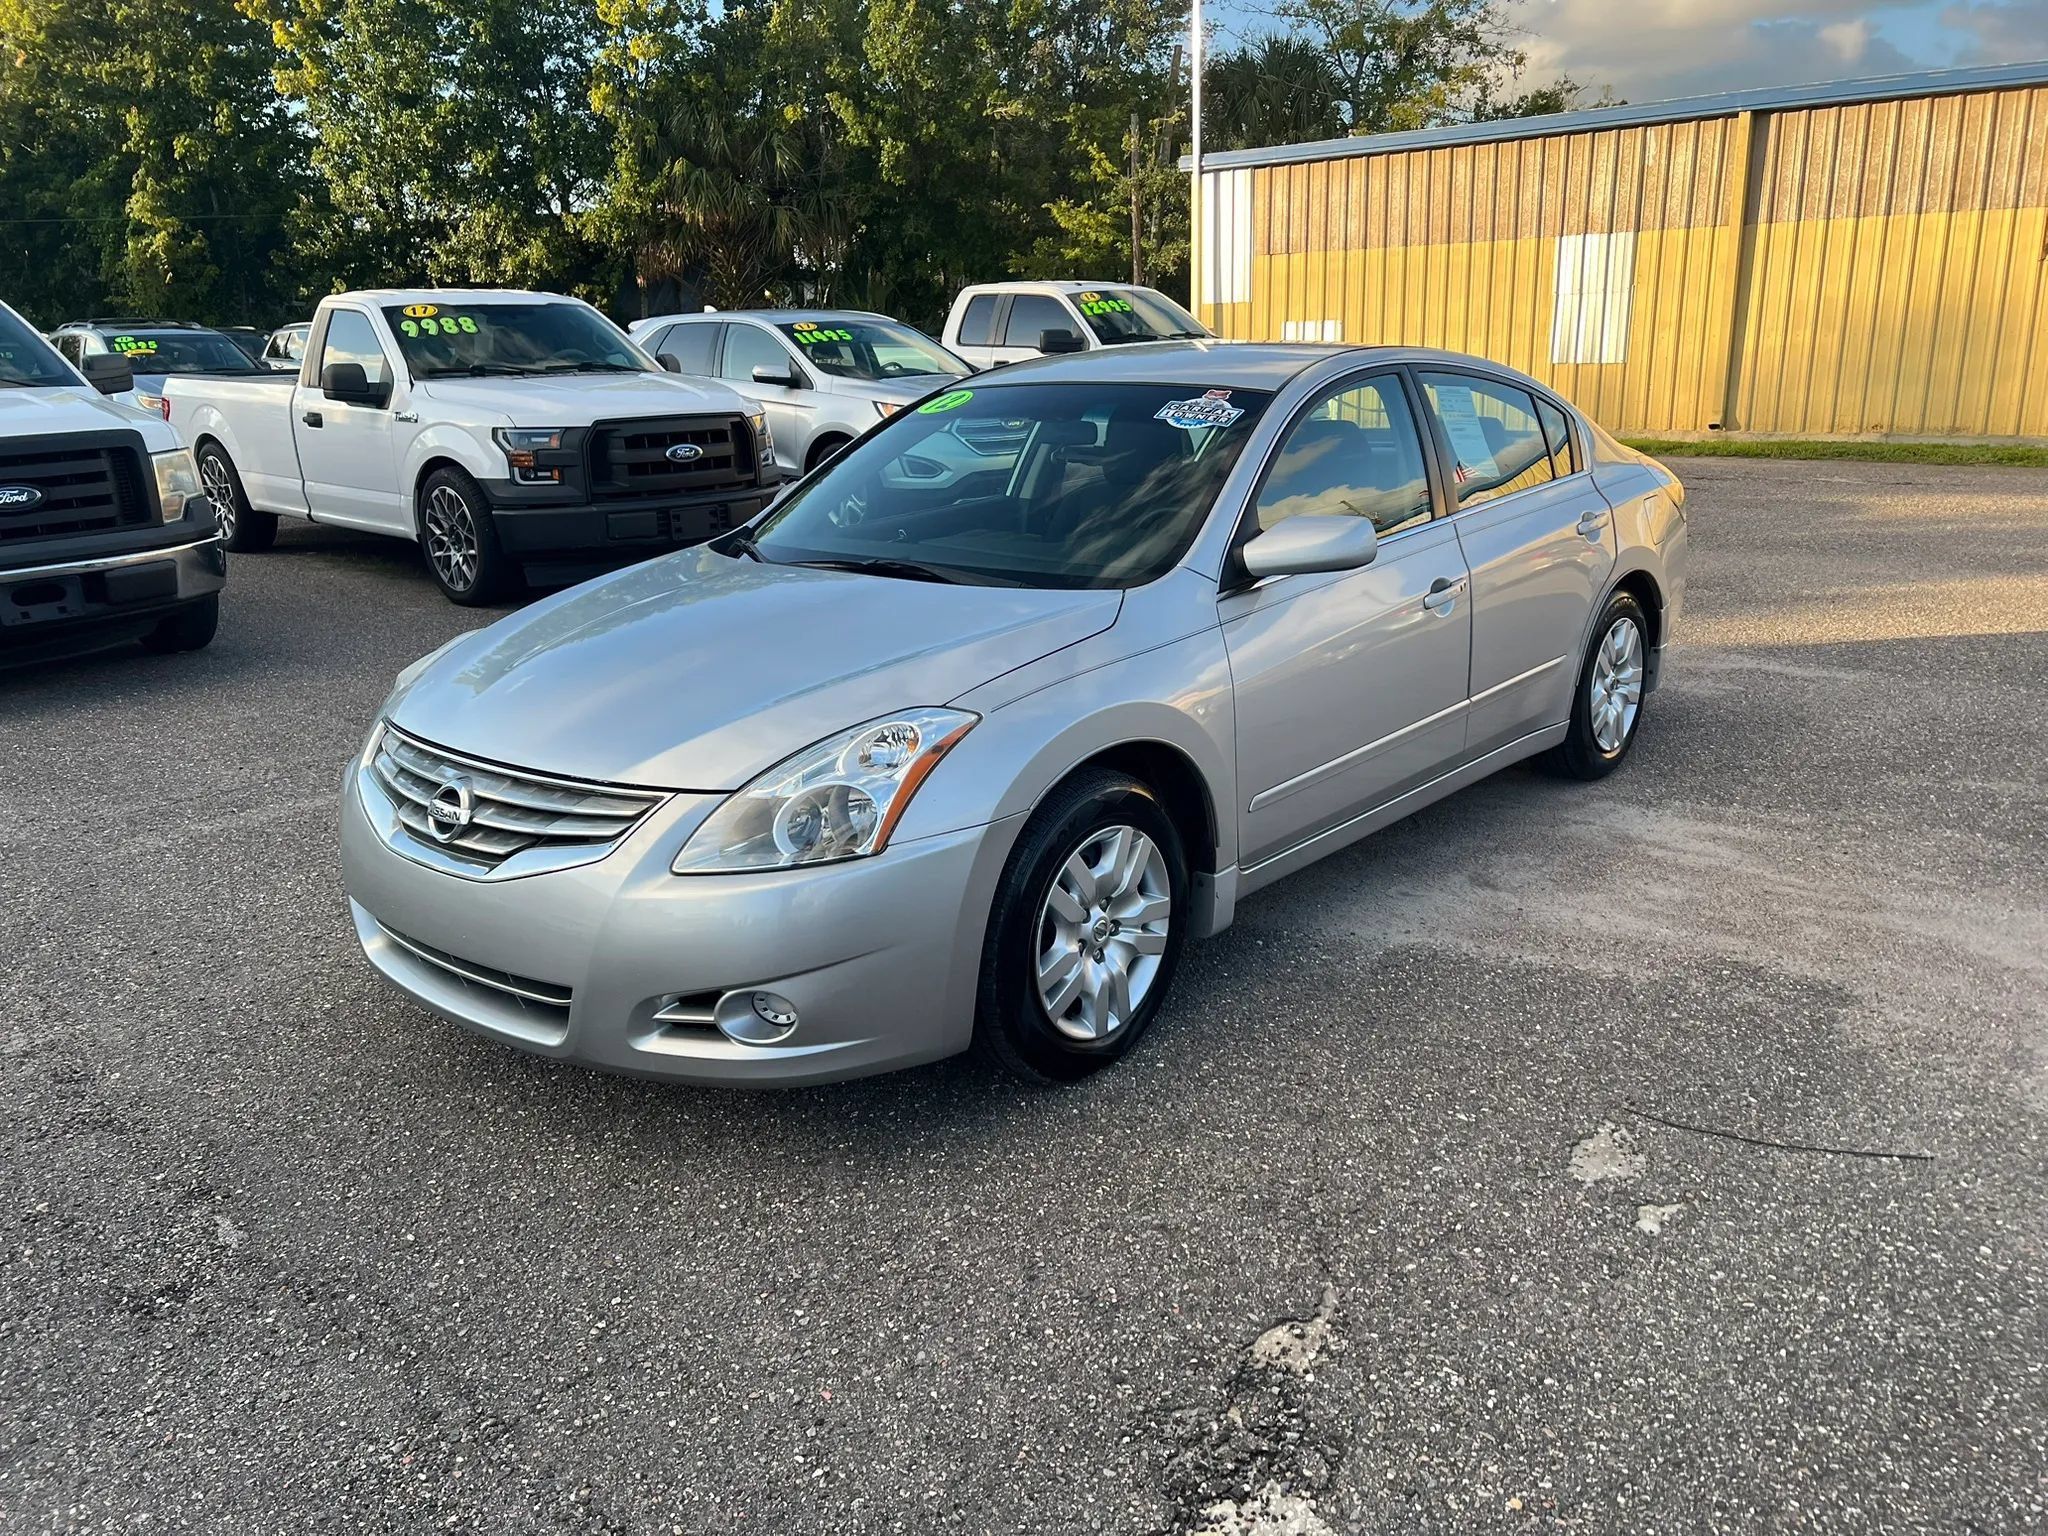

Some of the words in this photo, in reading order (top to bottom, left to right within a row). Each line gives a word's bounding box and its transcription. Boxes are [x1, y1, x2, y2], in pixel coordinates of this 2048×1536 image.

[410, 305, 429, 316] 17
[1080, 299, 1133, 316] 12995
[400, 316, 479, 338] 9988
[113, 340, 158, 352] 11995
[1168, 403, 1236, 417] CARFAX
[1173, 411, 1230, 424] OWNER
[675, 447, 696, 459] Ford
[0, 490, 28, 504] Ford
